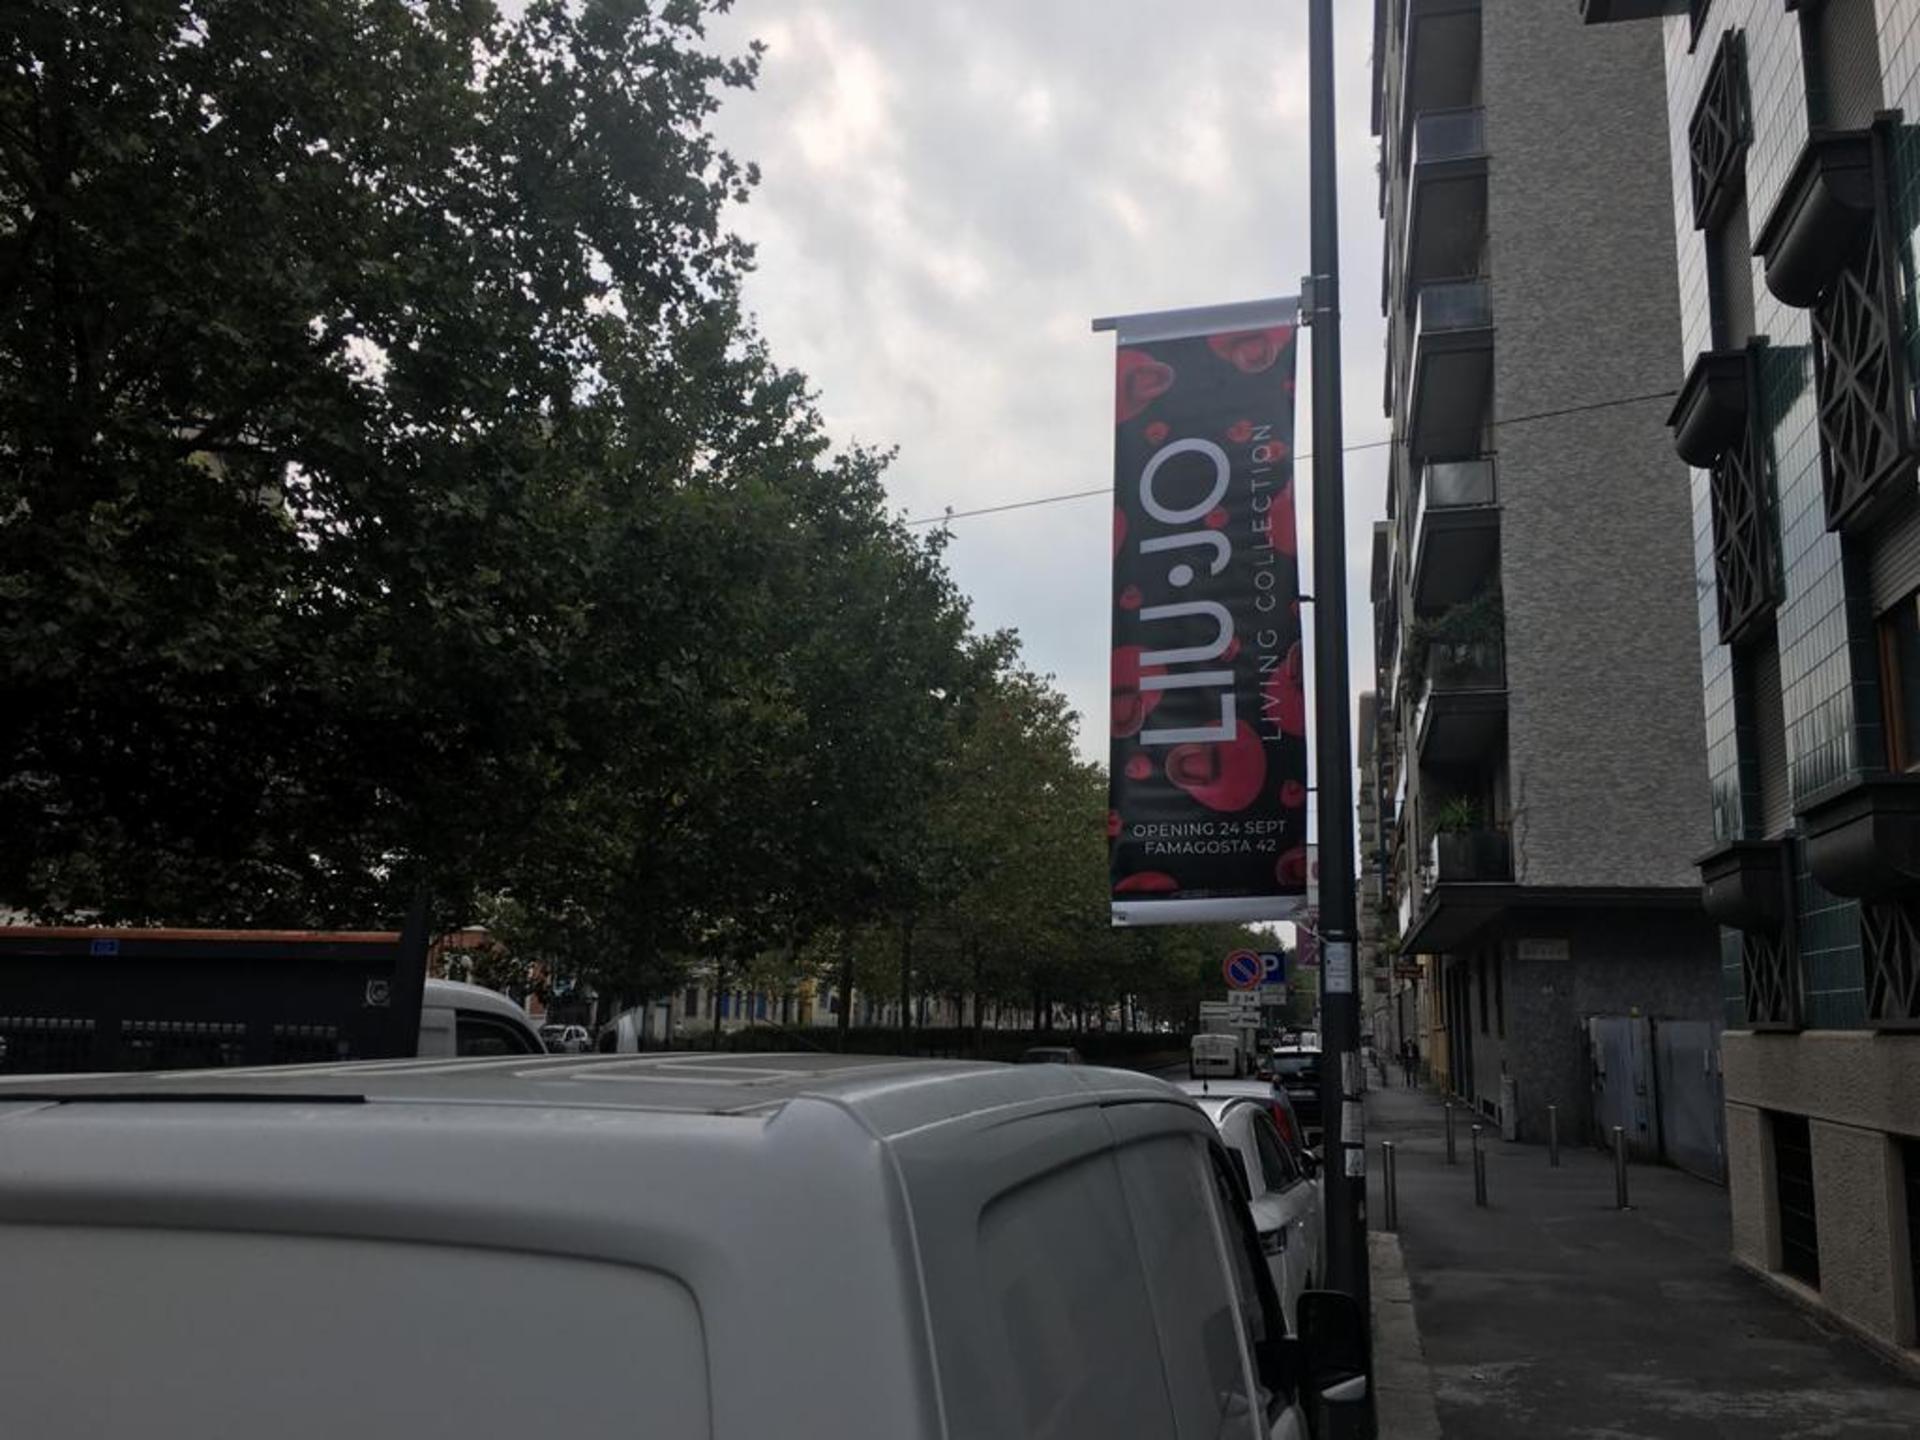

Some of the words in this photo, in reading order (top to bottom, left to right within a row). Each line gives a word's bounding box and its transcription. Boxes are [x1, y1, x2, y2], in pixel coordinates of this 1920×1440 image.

[1251, 423, 1278, 612] COLLECTION
[1258, 628, 1283, 741] LIVING
[1132, 822, 1215, 838] OPENING
[1219, 821, 1240, 836] 24
[1244, 820, 1287, 835] SEPT
[1144, 840, 1252, 856] FAMAGOSTA
[1256, 839, 1277, 853] 42
[1261, 954, 1280, 980] P
